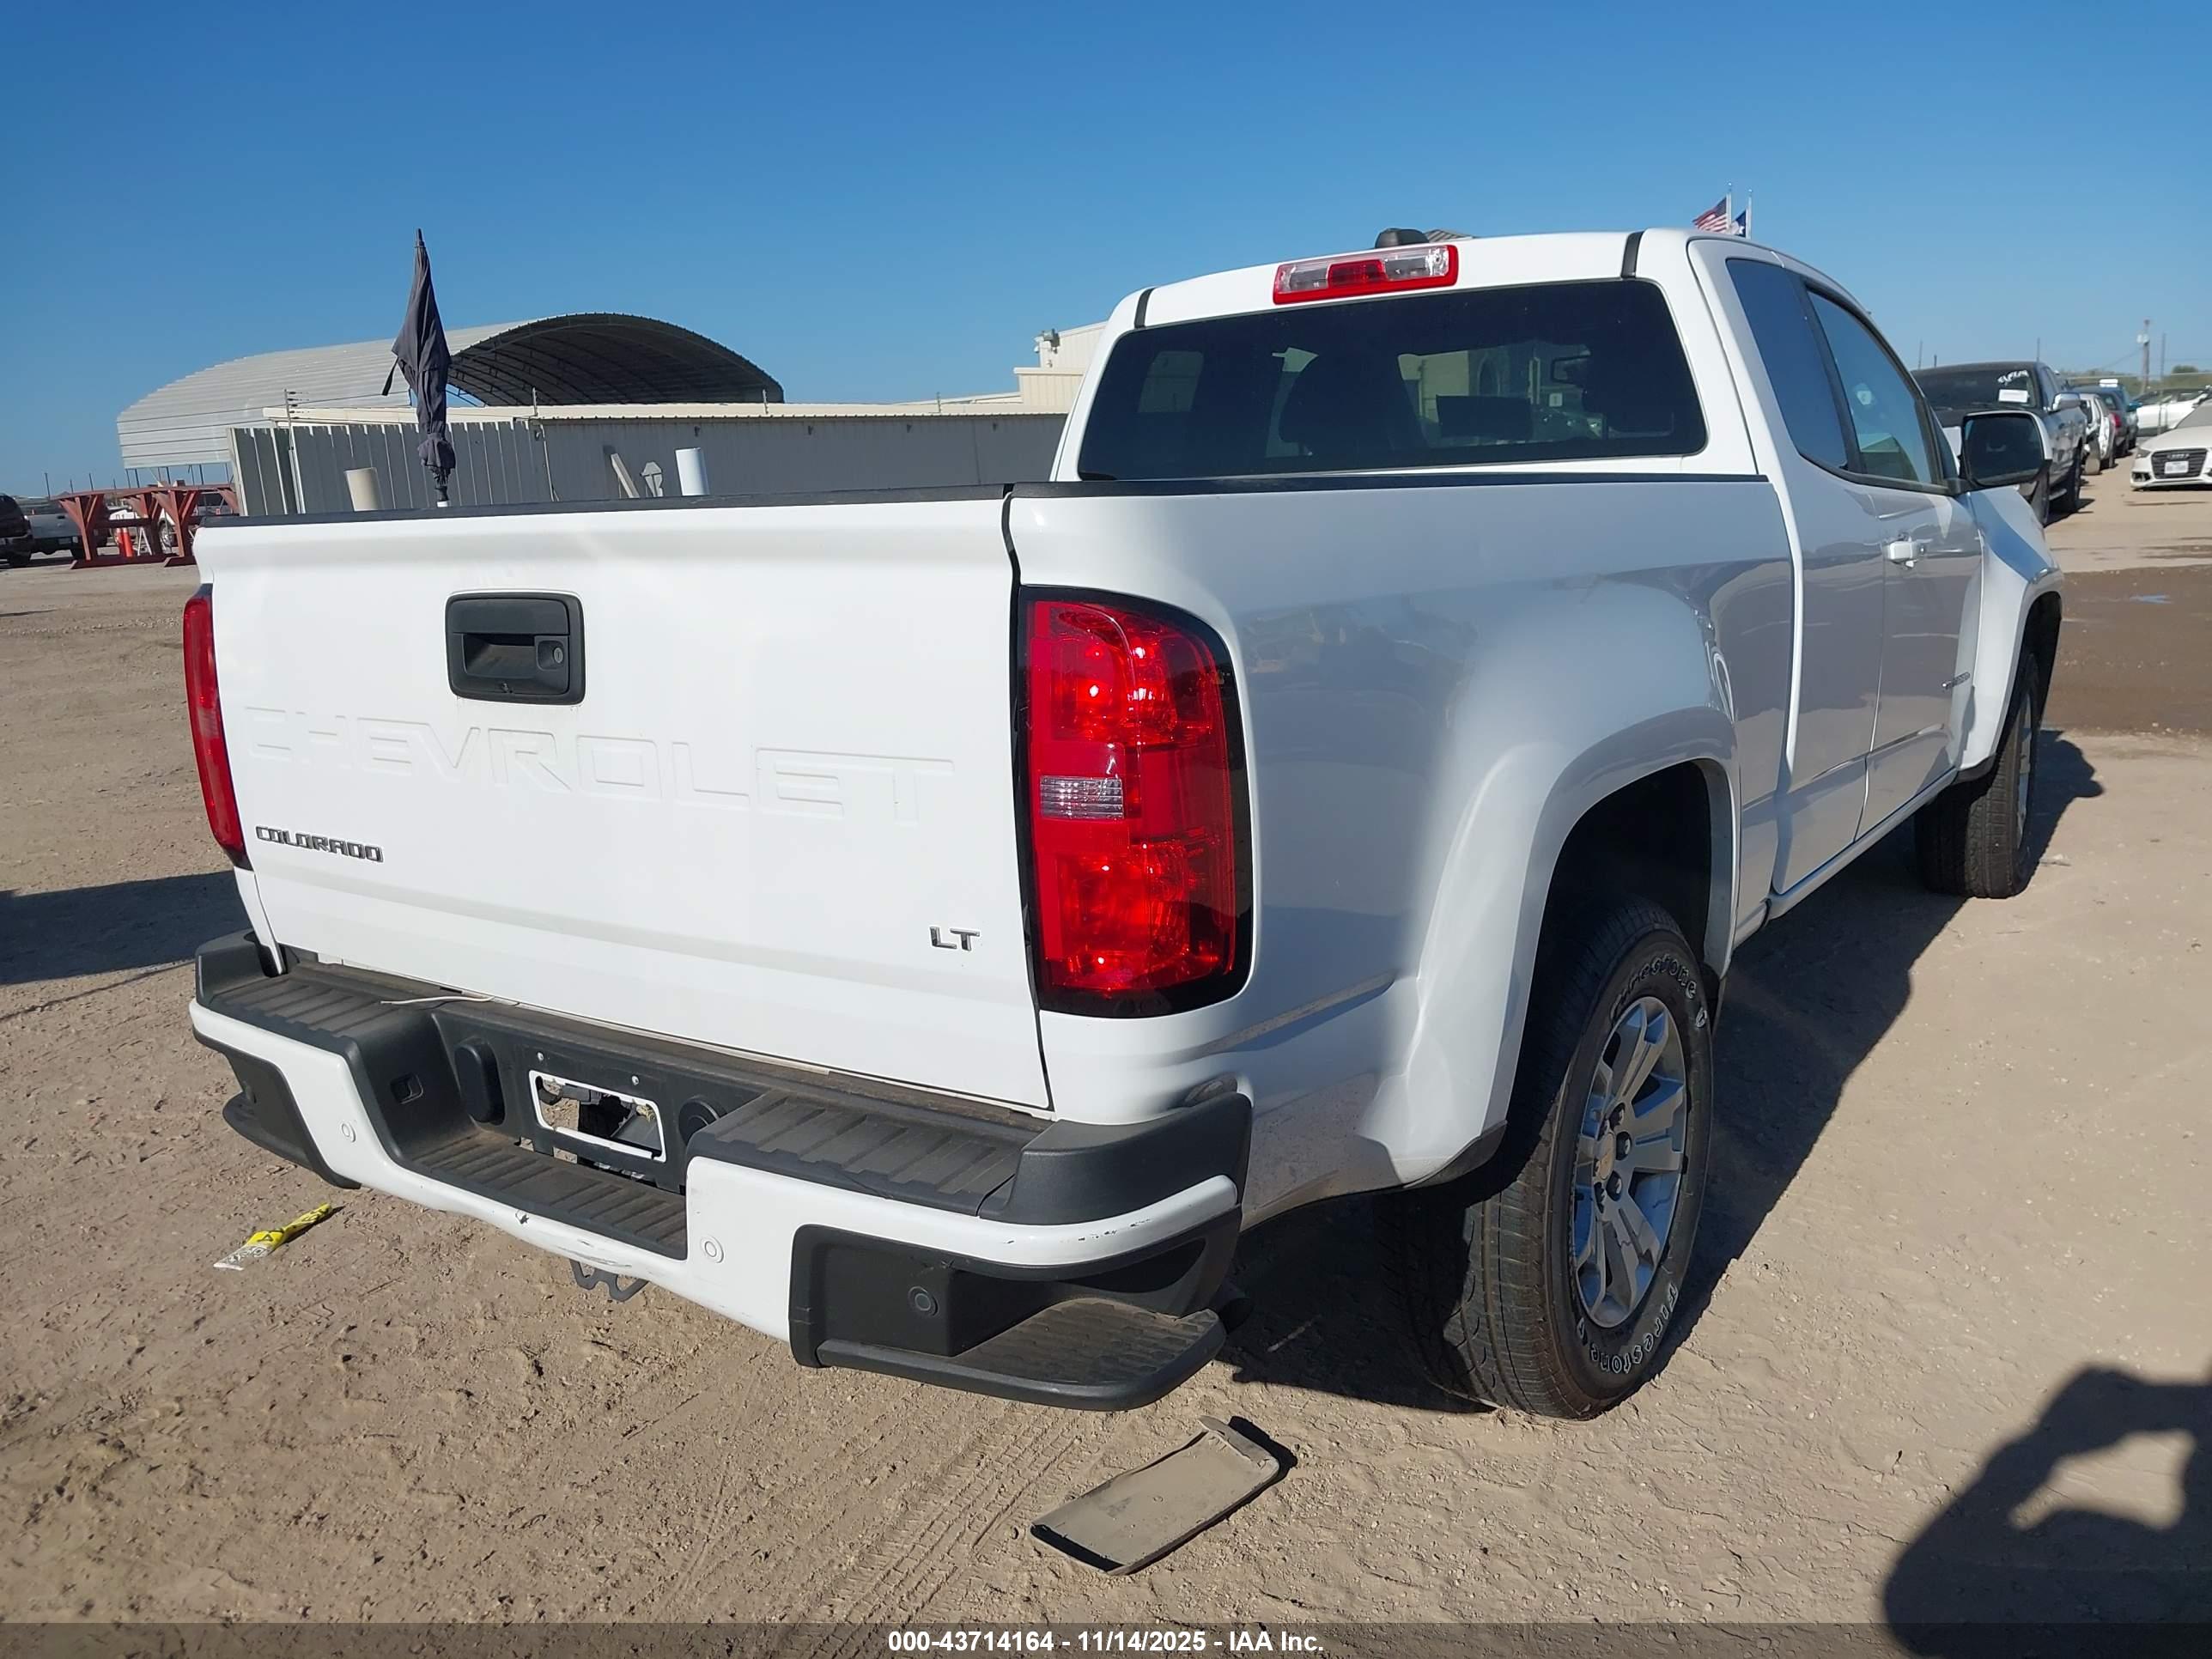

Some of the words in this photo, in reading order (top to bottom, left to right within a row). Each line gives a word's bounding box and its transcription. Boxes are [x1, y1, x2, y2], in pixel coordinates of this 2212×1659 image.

[246, 707, 954, 827] CHEVROLET
[256, 826, 385, 863] COLORADO
[929, 927, 981, 951] LT
